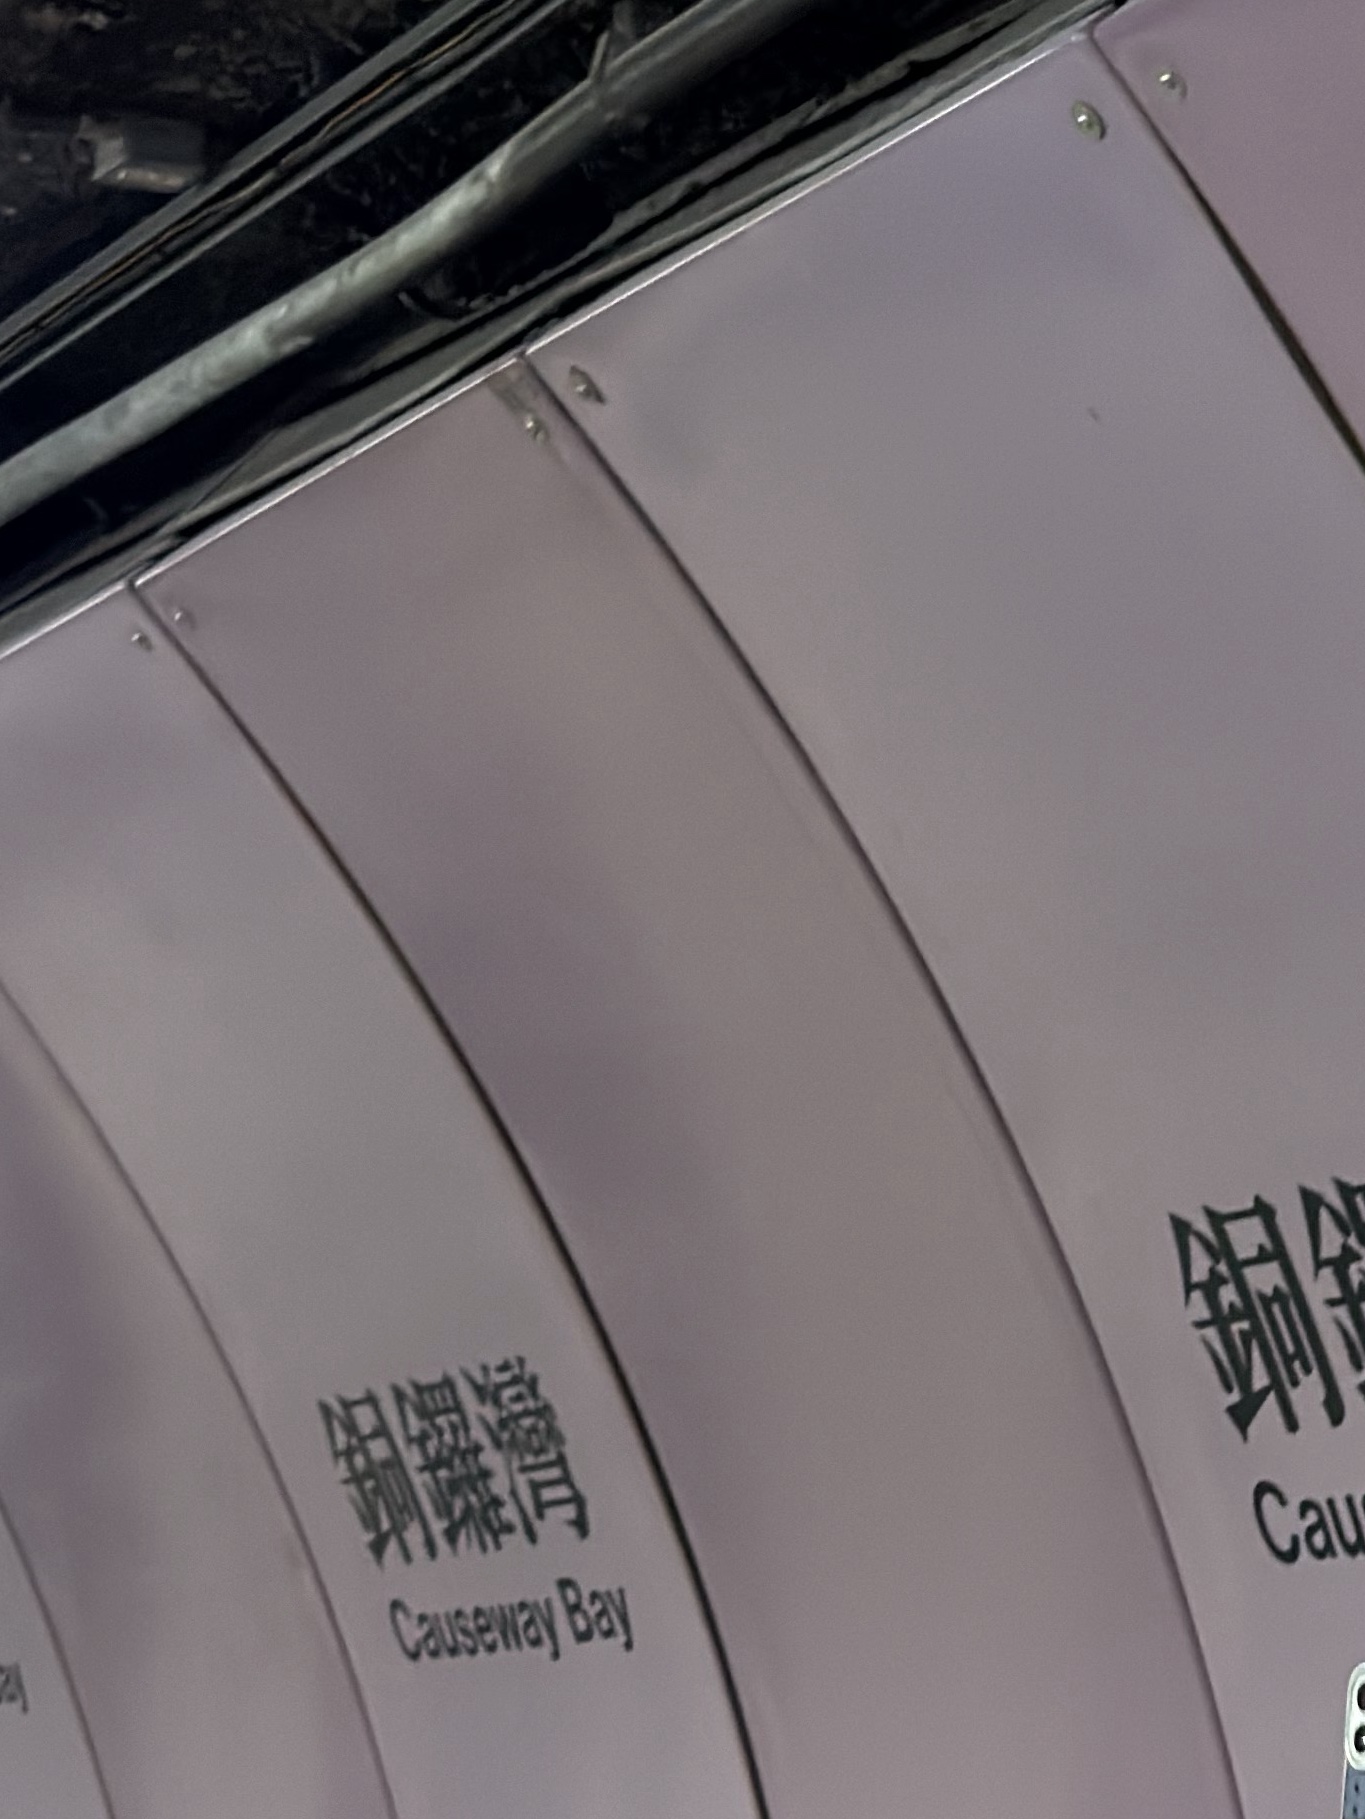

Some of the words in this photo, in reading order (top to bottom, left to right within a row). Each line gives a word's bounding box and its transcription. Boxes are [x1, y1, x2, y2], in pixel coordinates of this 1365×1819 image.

[317, 1355, 591, 1570] 銅鑼灣
[389, 1597, 561, 1662] Causeway
[555, 1577, 634, 1653] Bay
